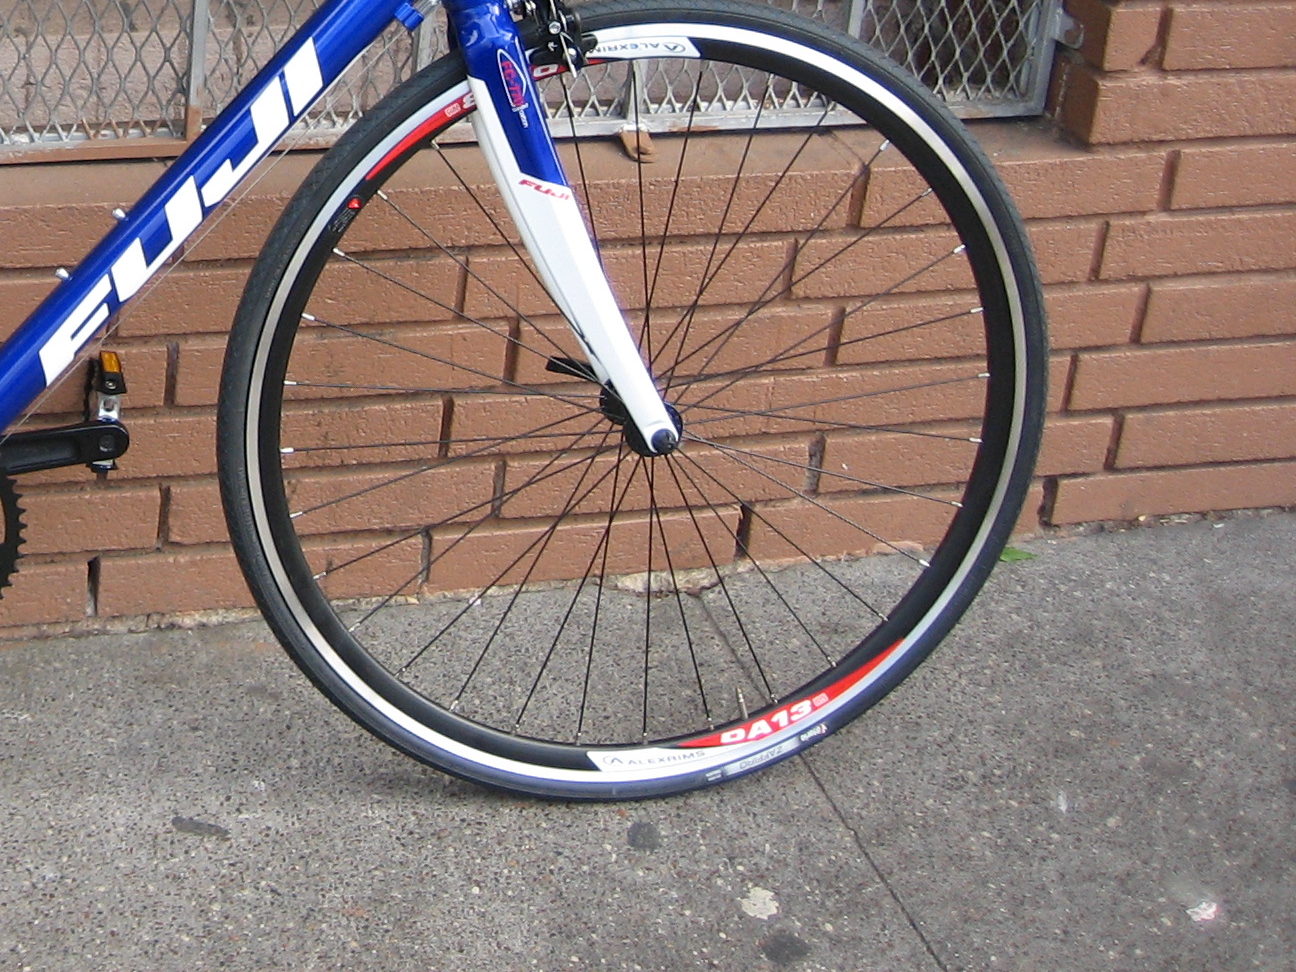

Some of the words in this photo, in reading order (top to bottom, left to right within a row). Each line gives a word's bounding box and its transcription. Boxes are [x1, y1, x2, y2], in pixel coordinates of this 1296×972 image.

[588, 41, 650, 55] ALEXRIM
[39, 36, 324, 387] FUJI
[720, 699, 813, 744] DA13
